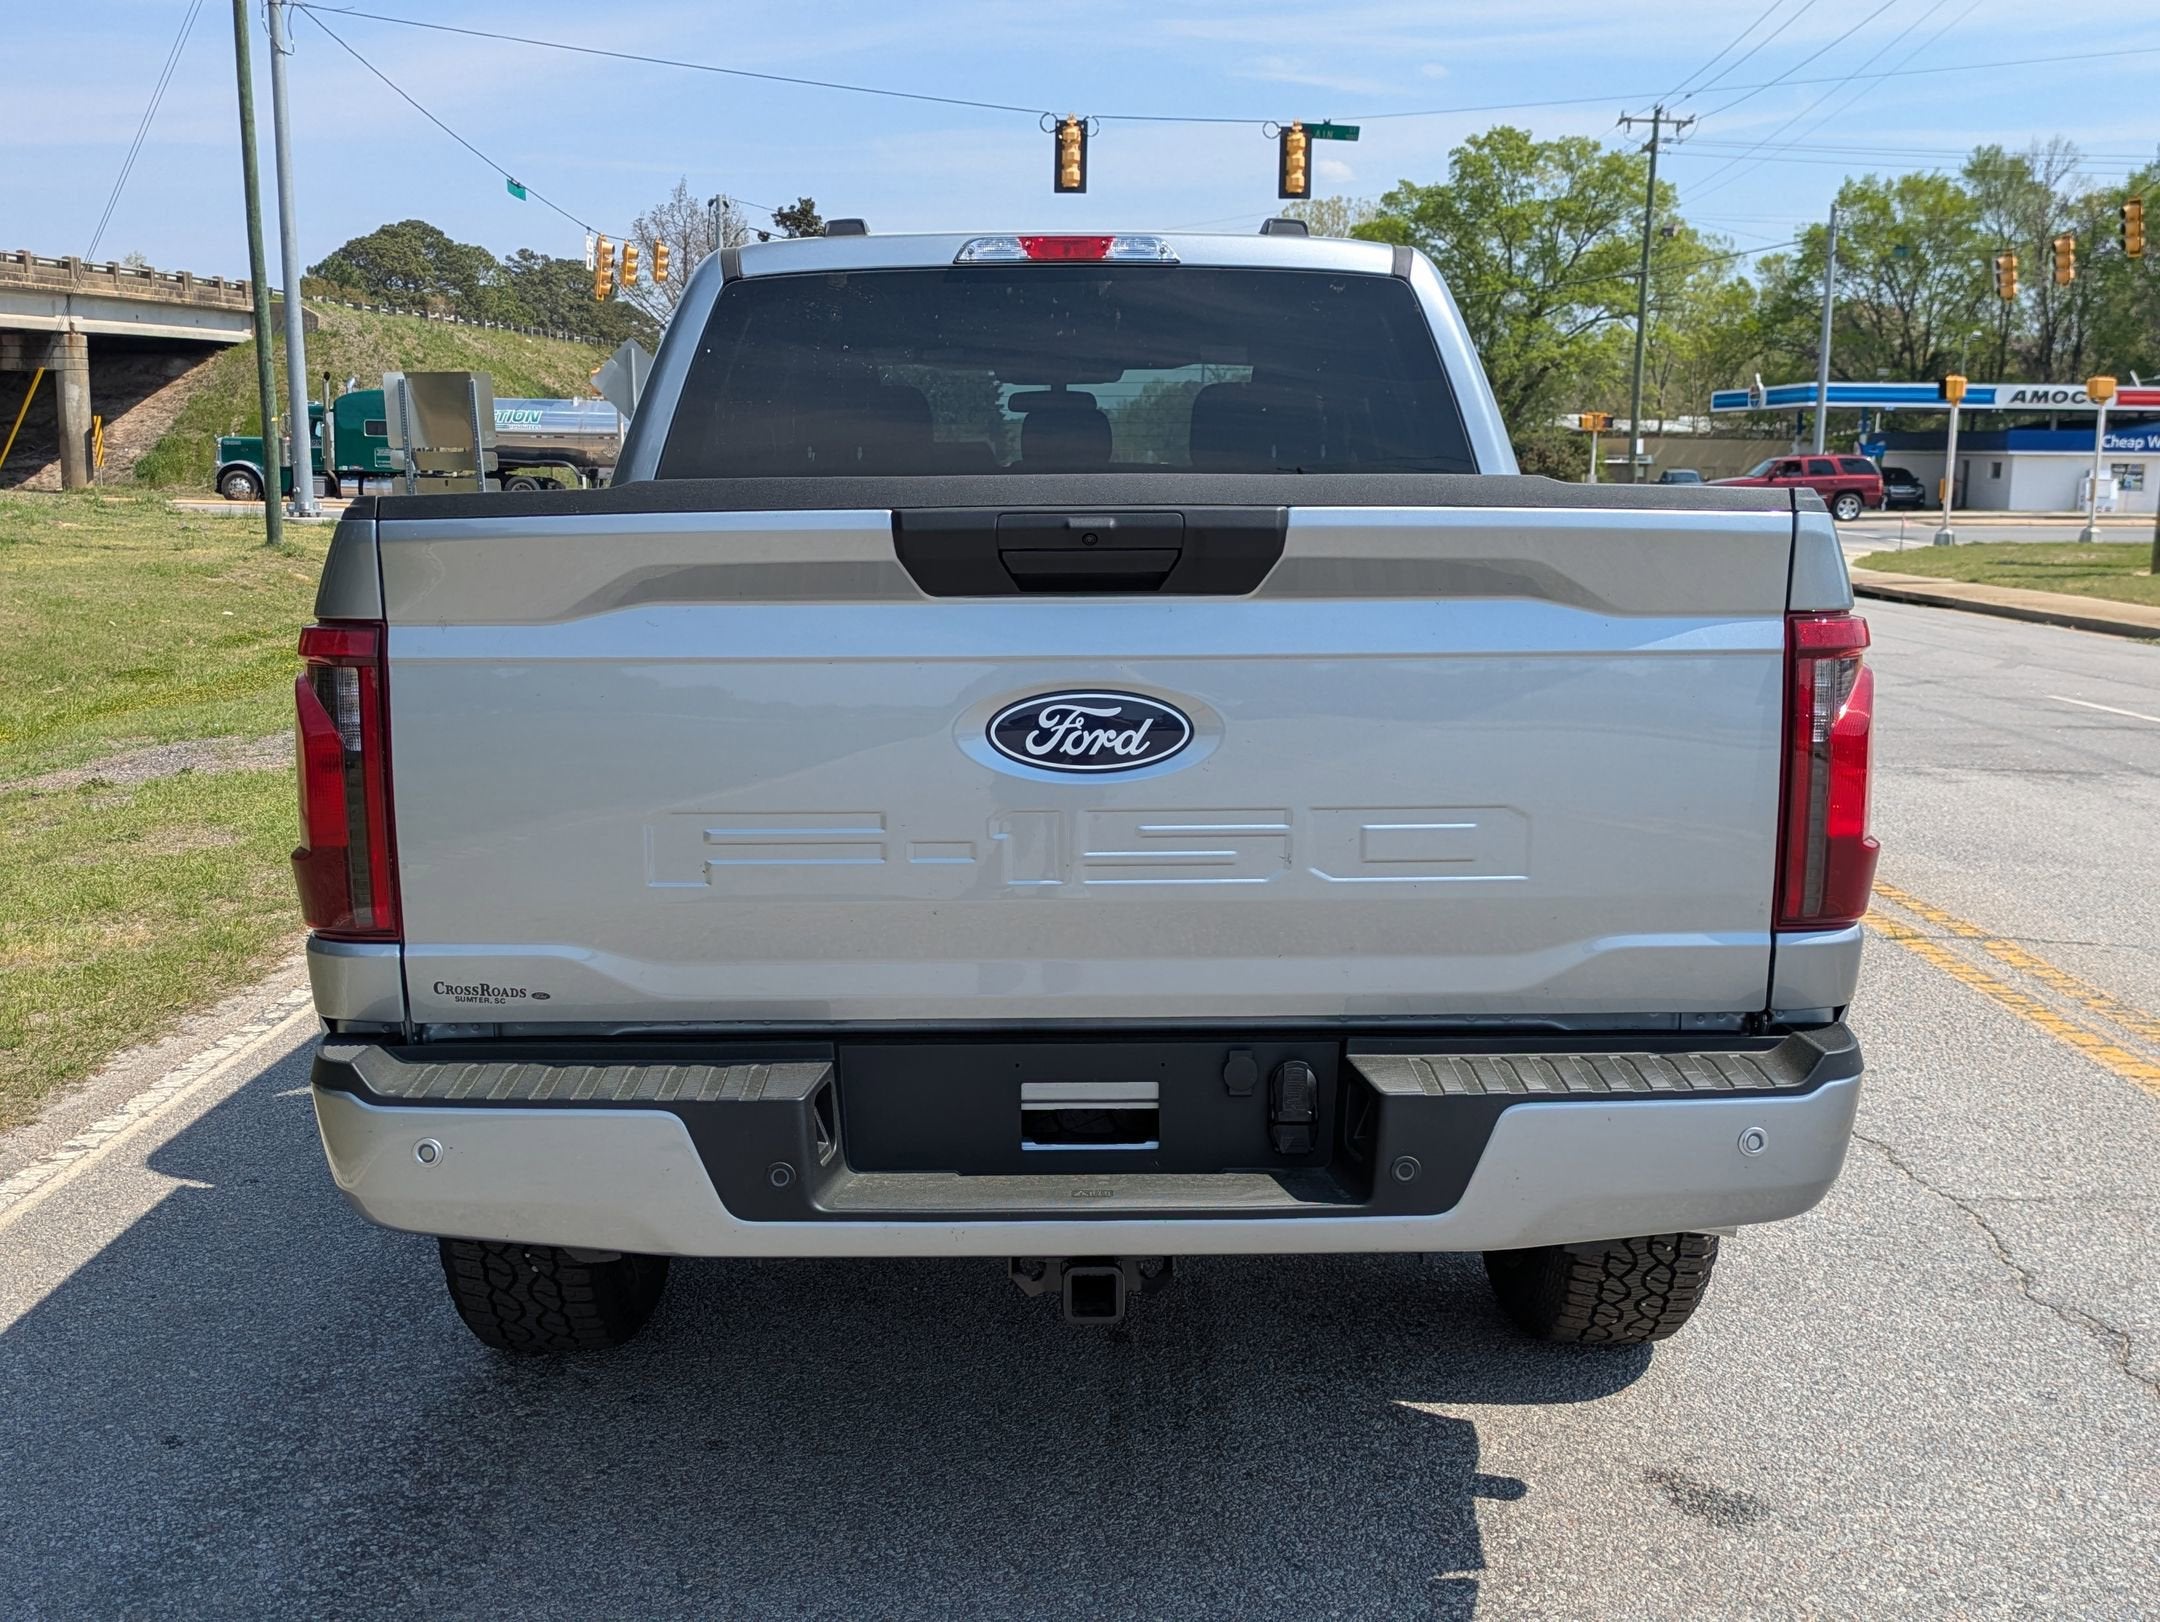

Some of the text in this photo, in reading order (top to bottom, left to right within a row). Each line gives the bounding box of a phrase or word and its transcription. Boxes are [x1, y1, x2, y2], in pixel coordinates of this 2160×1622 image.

[2010, 390, 2100, 404] AMOC
[2102, 434, 2145, 452] Cheap
[1025, 704, 1154, 756] Ford
[645, 804, 1531, 888] F-150
[494, 997, 506, 1005] SC
